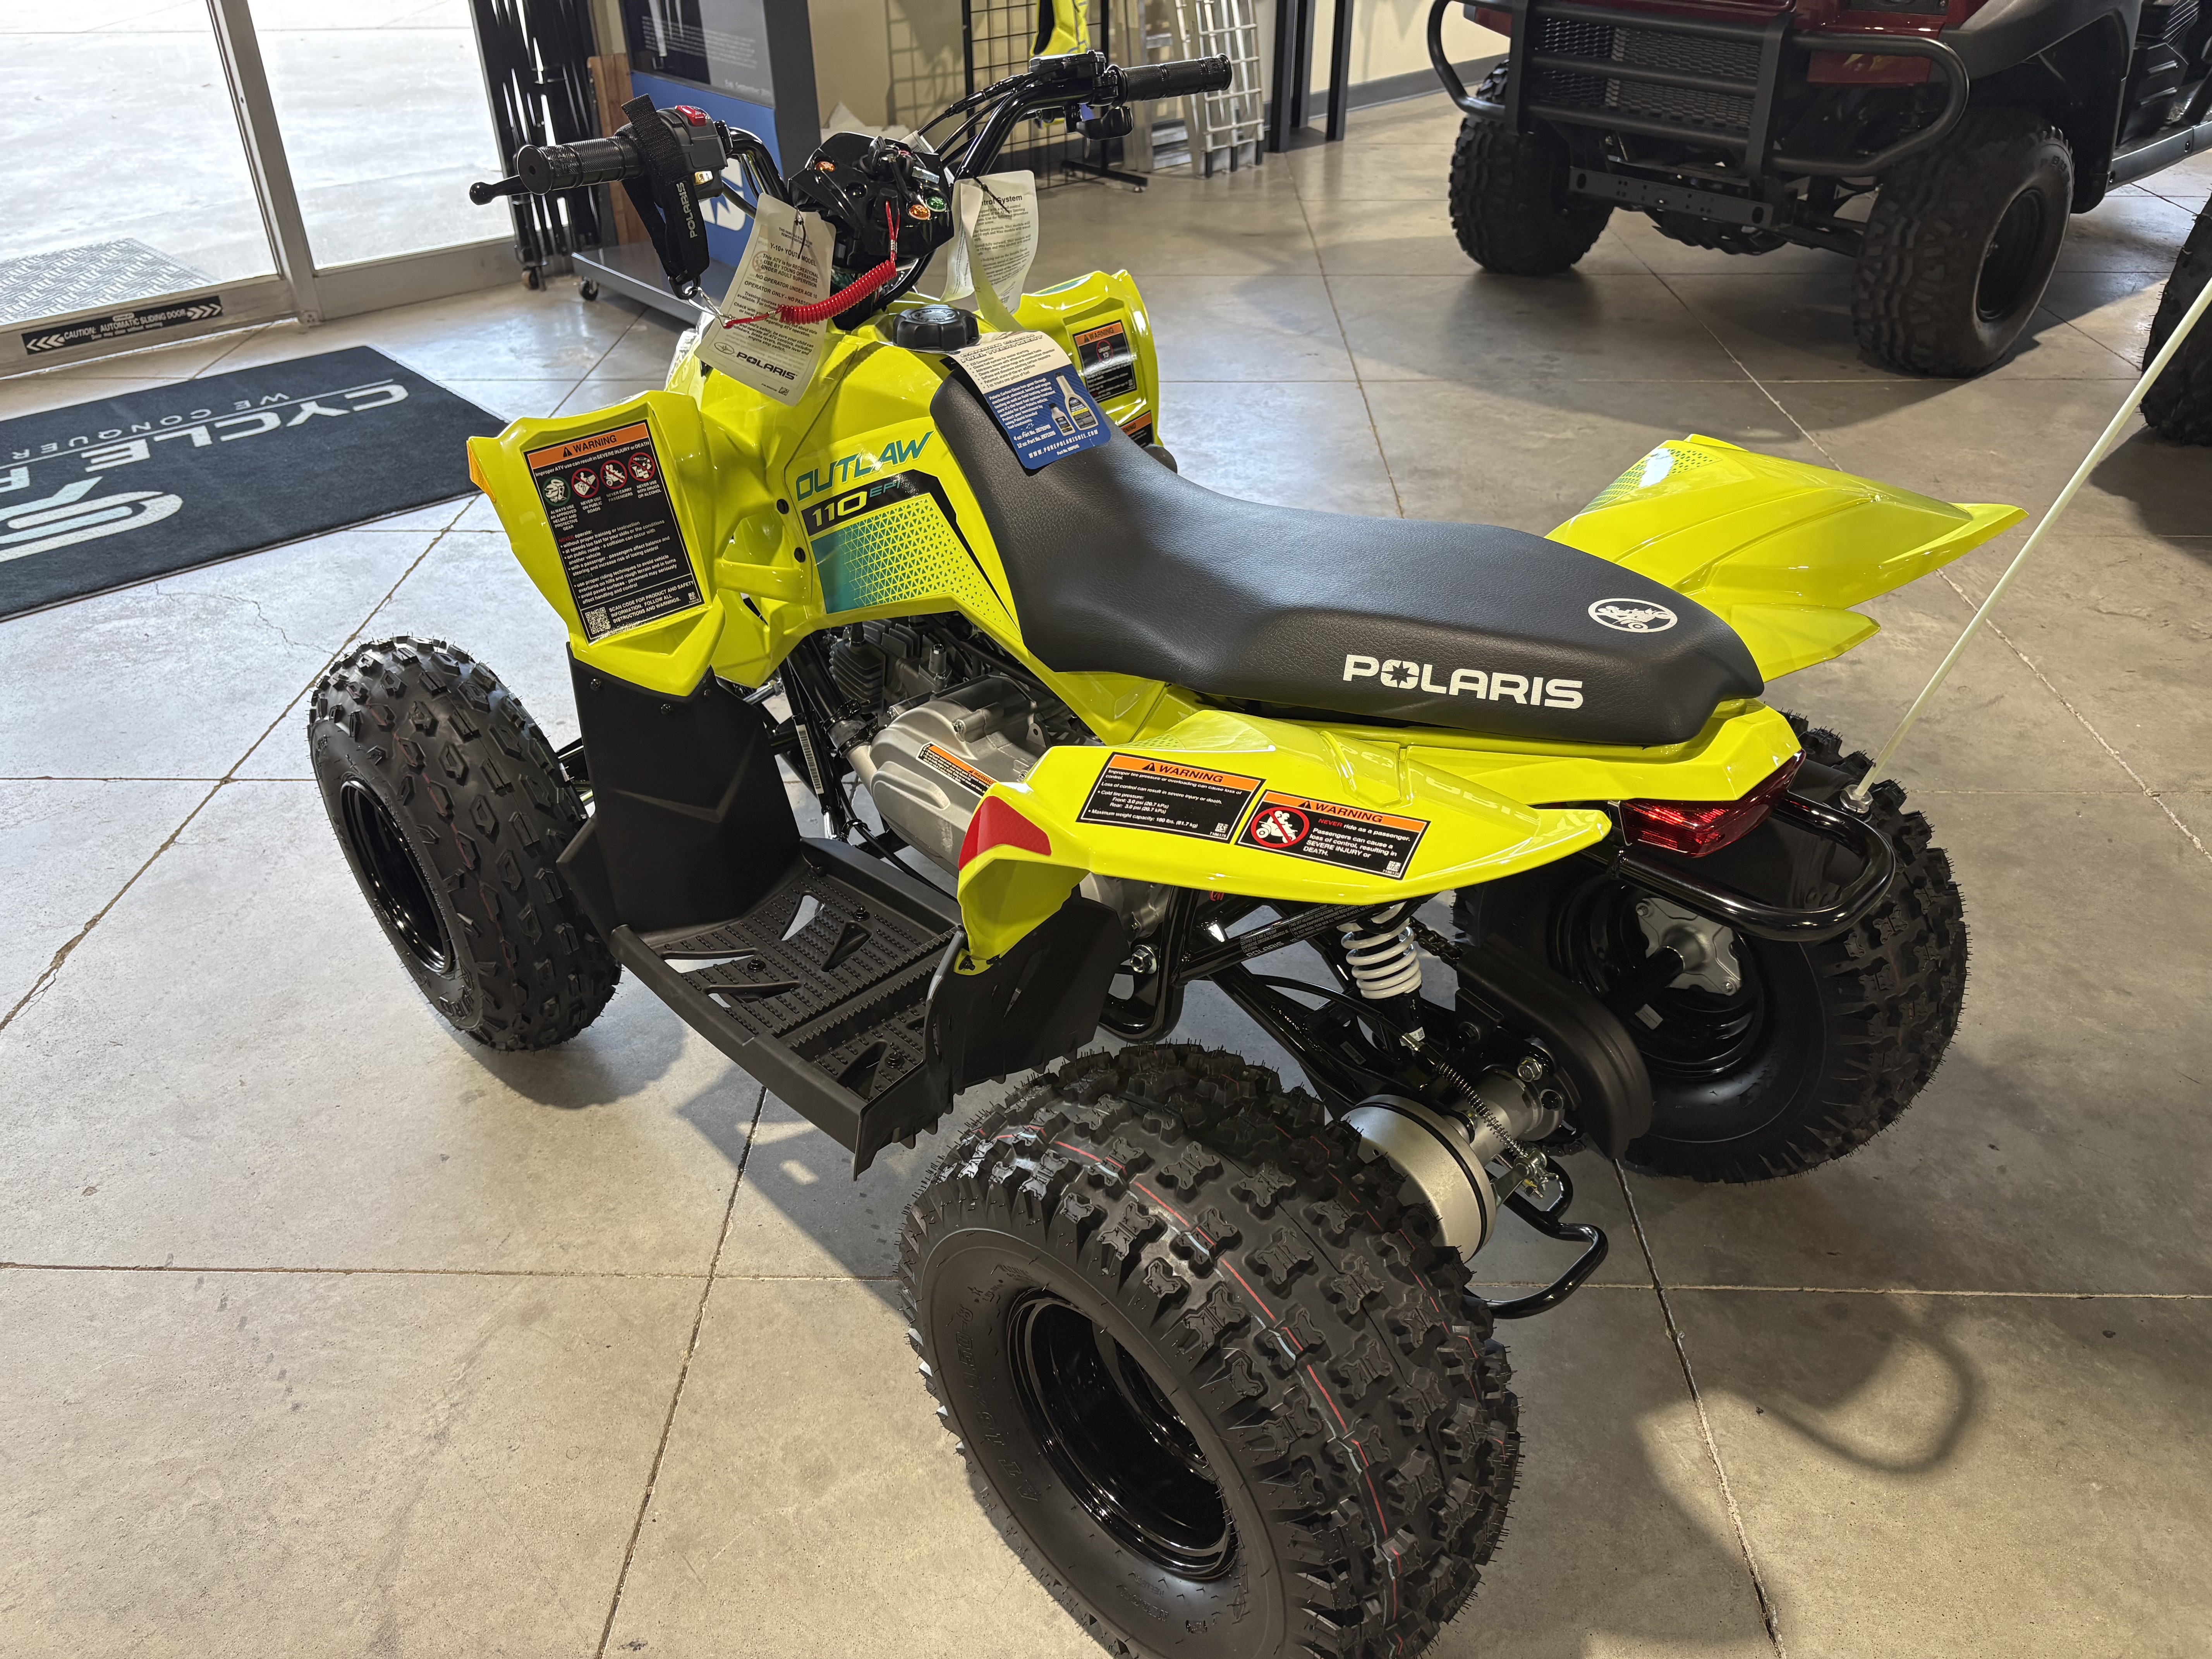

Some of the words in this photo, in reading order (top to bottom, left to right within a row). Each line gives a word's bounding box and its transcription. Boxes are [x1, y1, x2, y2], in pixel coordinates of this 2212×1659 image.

[997, 196, 1022, 204] System
[793, 264, 819, 278] RECREATIONAL
[802, 255, 816, 266] MODEL
[761, 264, 777, 273] UNDER
[793, 276, 817, 288] SUPERVISION
[781, 266, 795, 274] YOUNG
[797, 271, 817, 283] OPERATORS
[745, 281, 771, 294] OPERATOR
[764, 277, 788, 289] OPERATOR
[790, 285, 804, 294] UNDER
[64, 328, 96, 340] CAUTION:
[100, 318, 140, 333] AUTOMATIC
[140, 313, 166, 325] SLIDING
[167, 309, 186, 319] DOOR
[1089, 327, 1114, 340] WARNING
[960, 353, 987, 363] FUEL
[988, 335, 1043, 355] TREATMENT
[736, 352, 795, 380] POLARIS
[235, 393, 289, 411] WE
[12, 409, 212, 460] CONQUER
[81, 384, 408, 472] CYCLE
[572, 434, 617, 453] WARNING
[535, 467, 555, 477] Improper
[596, 451, 614, 460] SEVERE
[614, 446, 630, 455] INJURY
[634, 441, 650, 449] DEATH
[796, 431, 936, 501] OUTLAW
[812, 491, 867, 527] 110
[562, 539, 580, 548] without
[579, 534, 594, 543] proper
[594, 529, 611, 539] training
[617, 520, 641, 532] instruction
[570, 543, 586, 553] speeds
[642, 519, 665, 530] conditions
[608, 604, 622, 613] SCAN
[622, 599, 635, 608] CODE
[645, 589, 667, 600] PRODUCT
[677, 580, 694, 589] SAFETY
[610, 603, 643, 618] INFORMATION.
[644, 596, 663, 607] FOLLOW
[612, 608, 646, 623] INSTRUCTIONS
[655, 596, 681, 609] WARNINGS.
[1343, 654, 1583, 709] POLARIS
[1158, 765, 1224, 783] WARNING
[1166, 778, 1197, 787] overloading
[1313, 803, 1384, 823] WARNING
[1311, 828, 1352, 841] Passengers
[1365, 838, 1388, 848] cause
[1317, 819, 1343, 828] NEVER
[1372, 829, 1412, 842] passenger.
[1302, 846, 1330, 856] DEATH.
[1305, 840, 1335, 850] SEVERE
[1334, 845, 1363, 856] INJURY
[1308, 834, 1324, 842] loss
[1331, 838, 1359, 849] control,
[1358, 844, 1391, 855] resulting
